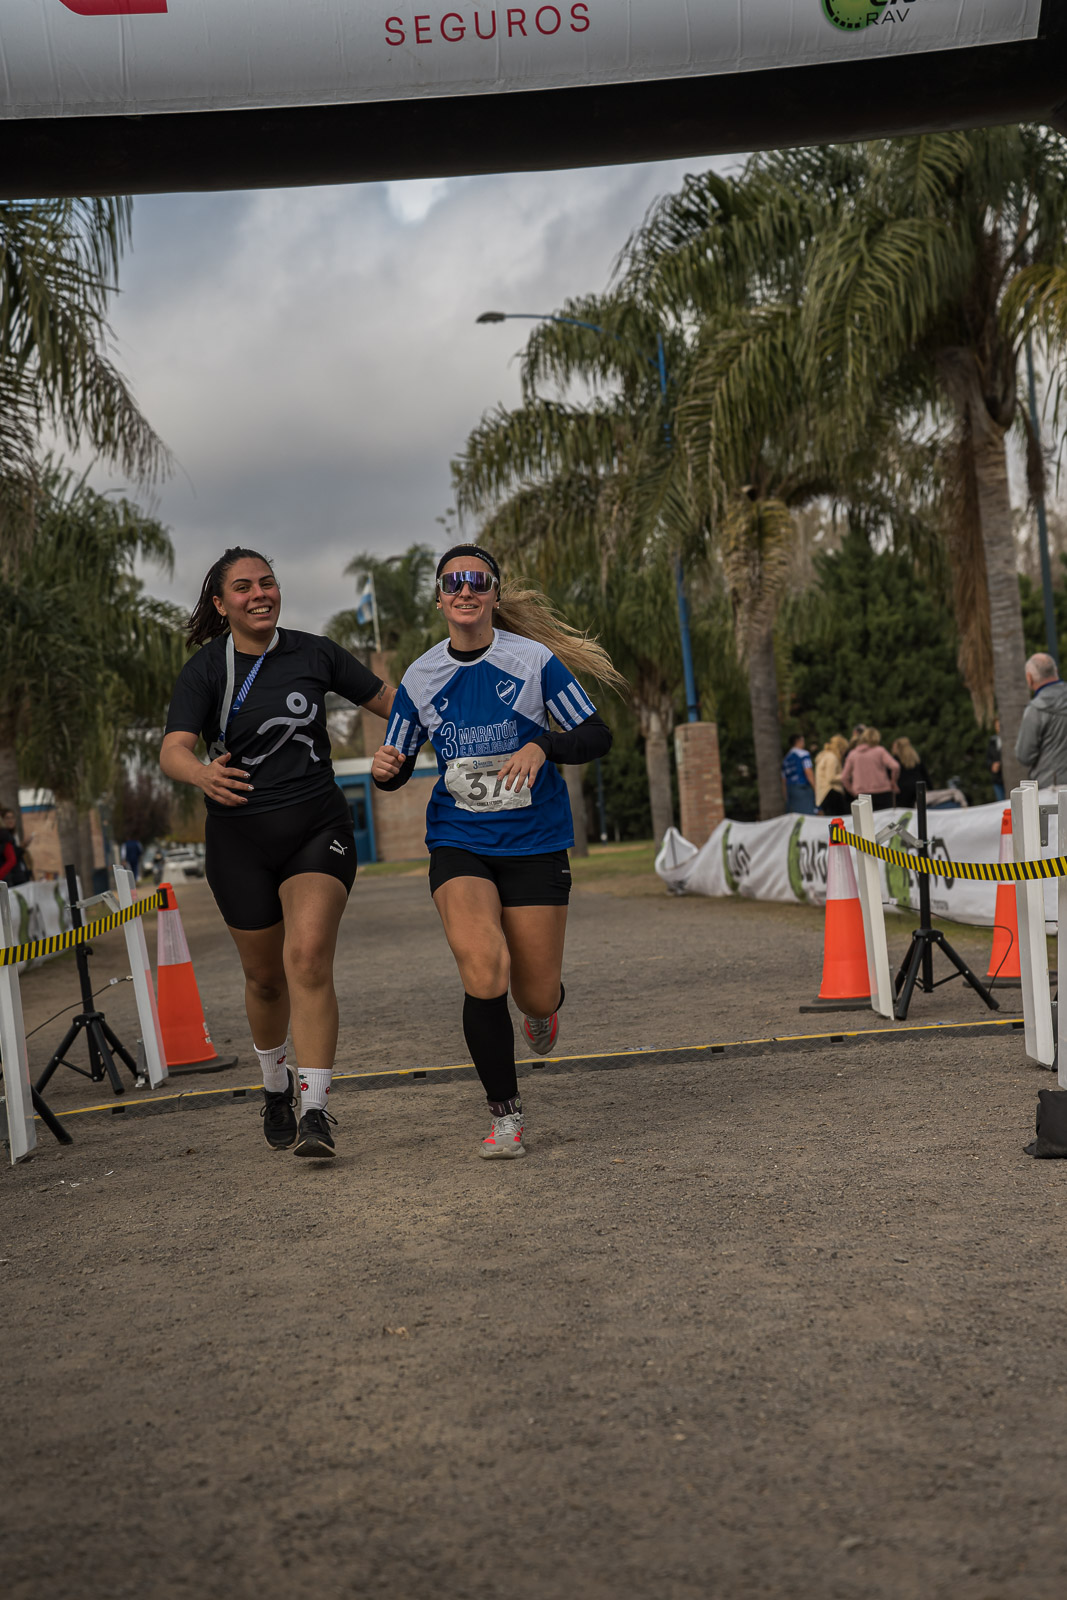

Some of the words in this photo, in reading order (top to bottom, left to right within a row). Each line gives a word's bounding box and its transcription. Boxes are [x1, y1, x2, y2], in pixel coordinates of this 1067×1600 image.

[385, 3, 591, 46] SEGUROS
[866, 8, 910, 26] RAV
[441, 721, 459, 761] 3
[458, 719, 518, 746] MARATÓN
